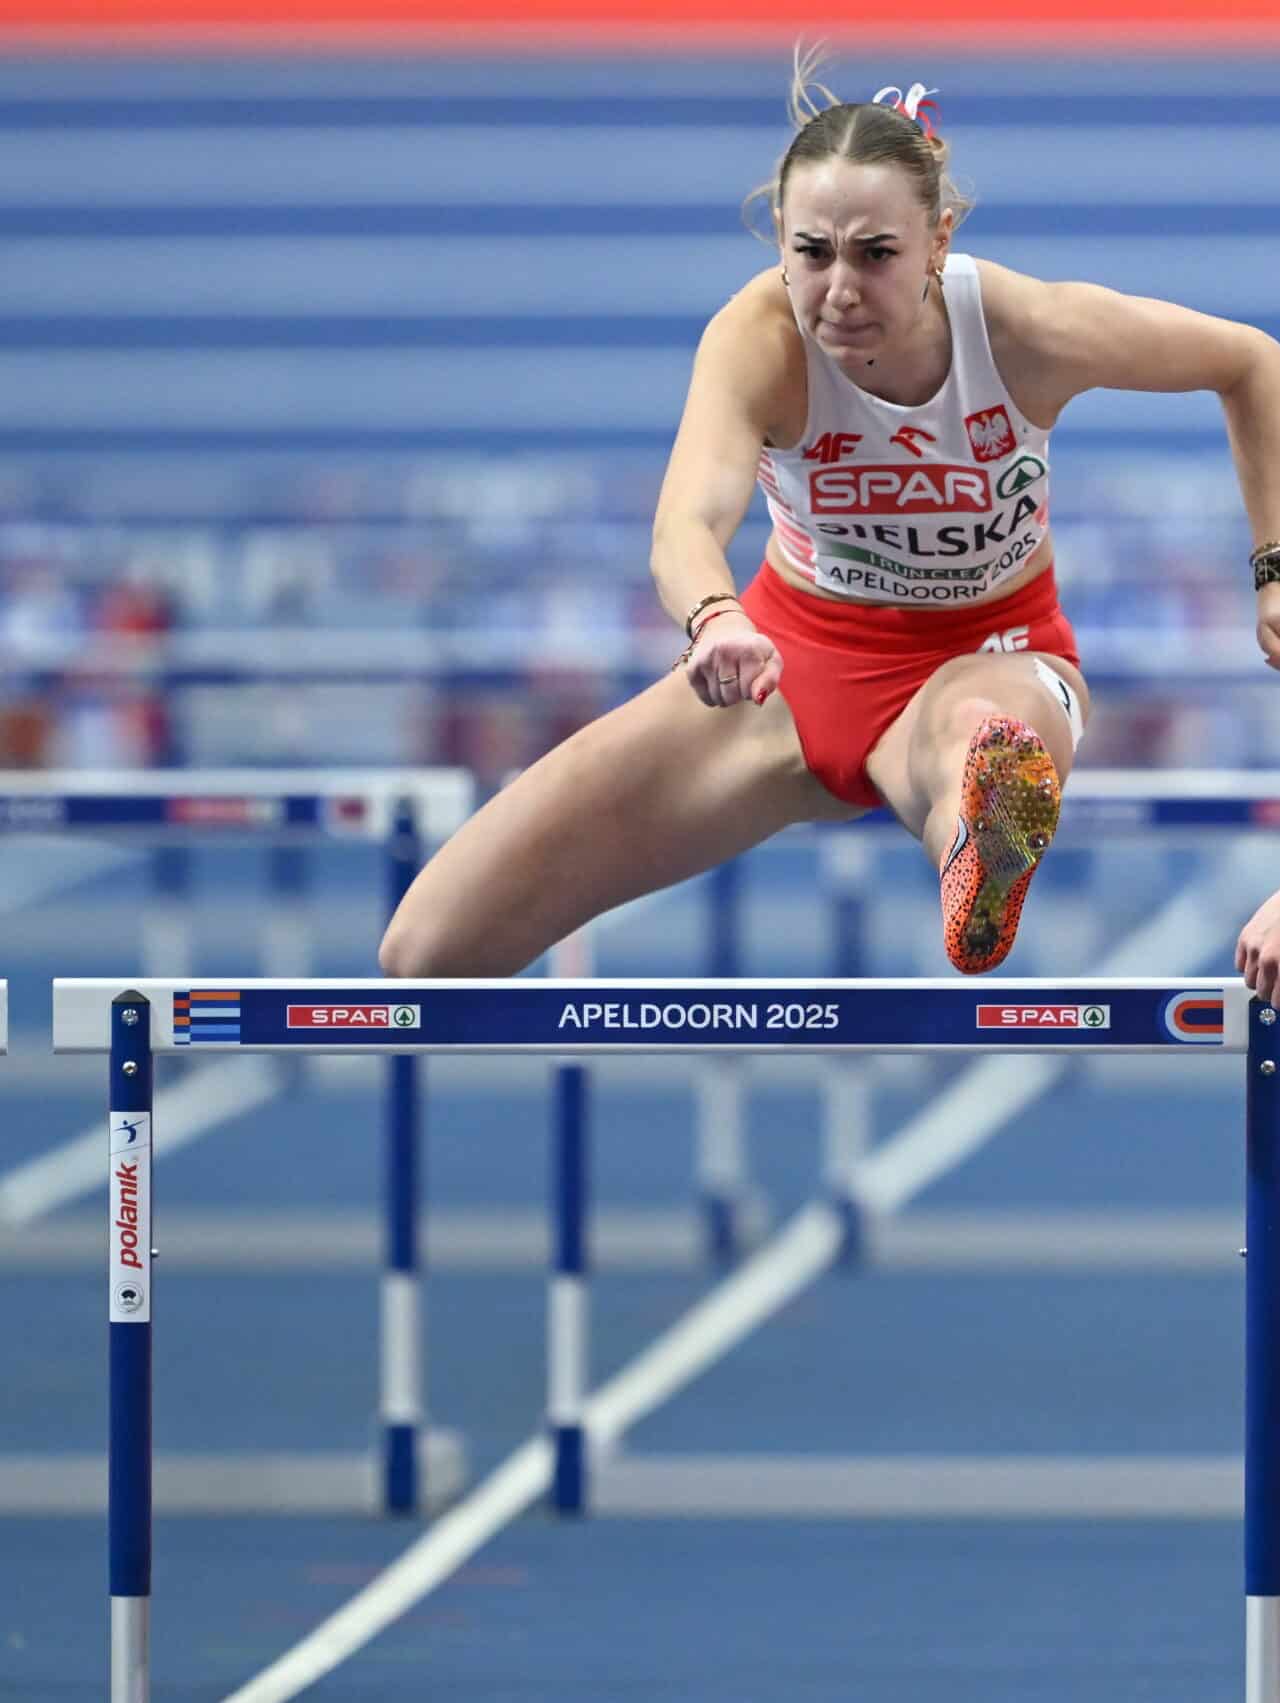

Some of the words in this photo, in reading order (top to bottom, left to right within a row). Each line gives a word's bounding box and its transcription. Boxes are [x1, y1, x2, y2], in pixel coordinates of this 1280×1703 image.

[814, 470, 988, 508] SPAR
[816, 494, 1038, 557] SIELSKA
[829, 566, 987, 600] APELDOORN
[991, 532, 1039, 580] 2025
[930, 565, 985, 579] CLEA
[311, 1009, 387, 1024] SPAR
[558, 1003, 757, 1029] APELDOORN
[766, 1003, 839, 1029] 2025
[1001, 1009, 1077, 1024] SPAR
[115, 1163, 144, 1269] polanik
